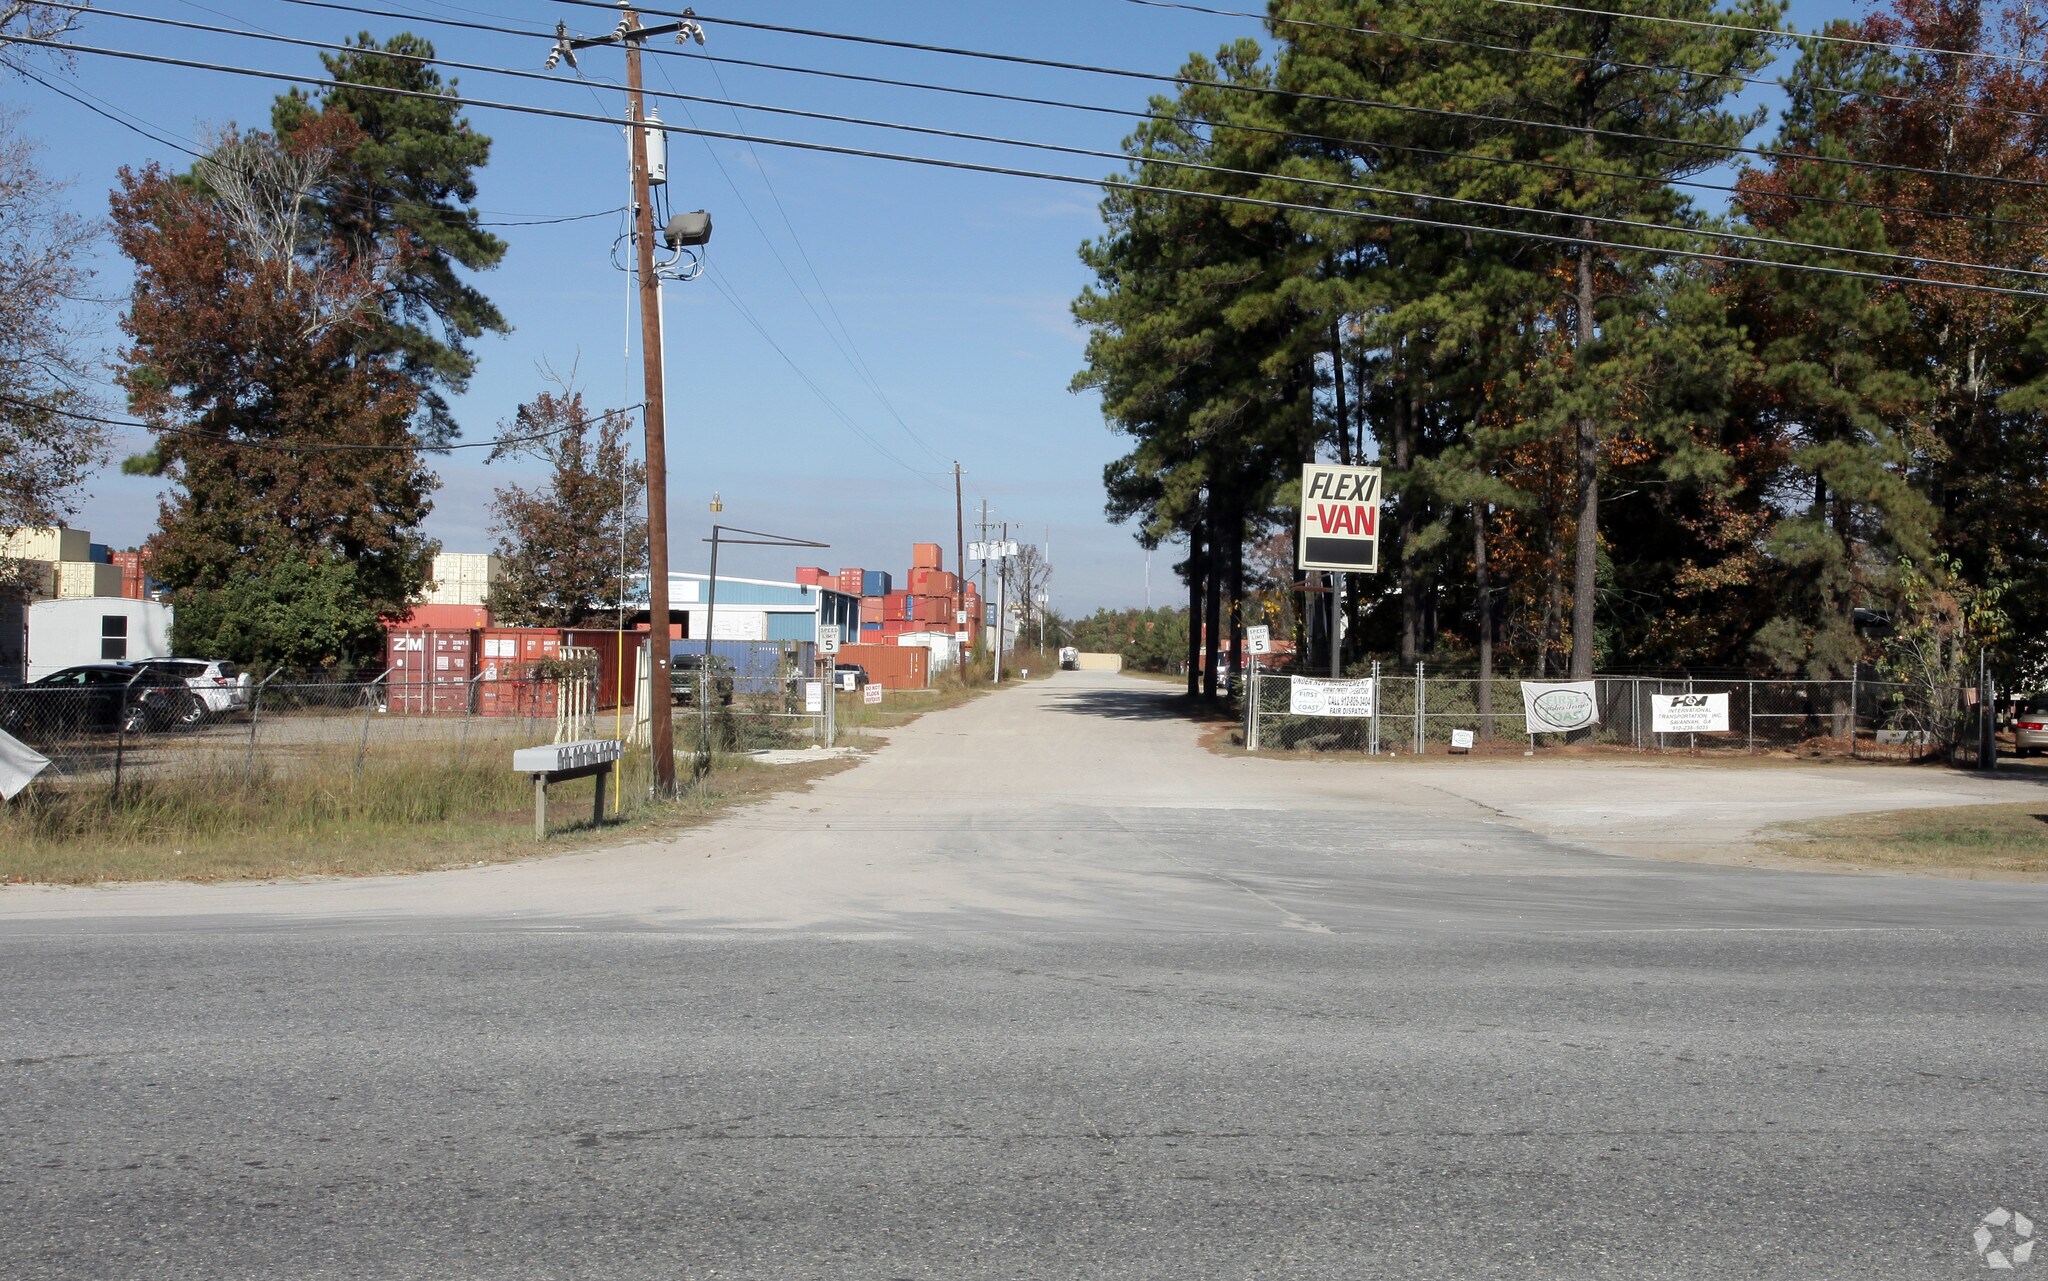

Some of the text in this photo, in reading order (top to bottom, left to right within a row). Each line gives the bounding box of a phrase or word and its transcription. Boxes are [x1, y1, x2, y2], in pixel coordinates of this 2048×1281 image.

[1308, 472, 1378, 501] FLEXI
[1307, 503, 1375, 536] -VAN
[393, 637, 423, 651] ZIM
[825, 640, 833, 650] 5
[1255, 640, 1264, 651] 5
[1328, 696, 1340, 706] CALL
[1546, 695, 1580, 704] FIRST
[1329, 707, 1369, 715] FAIR DISPATCH
